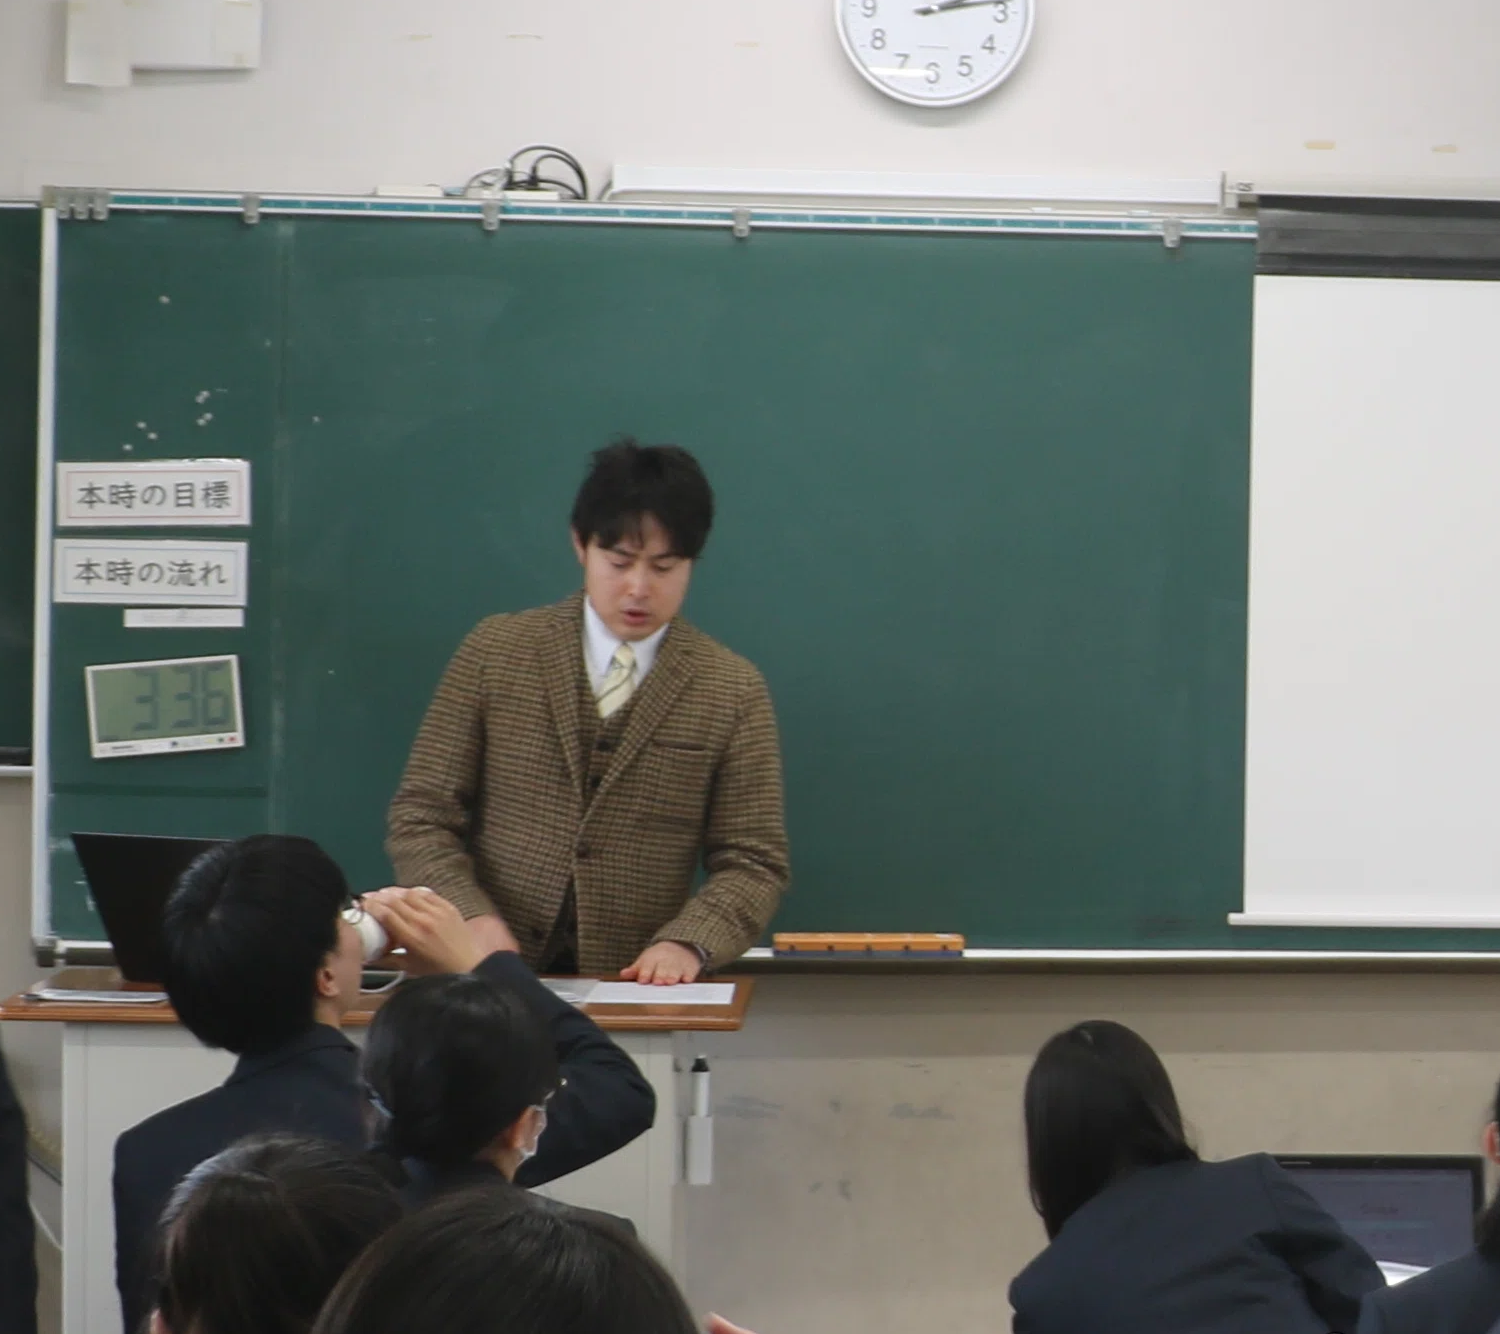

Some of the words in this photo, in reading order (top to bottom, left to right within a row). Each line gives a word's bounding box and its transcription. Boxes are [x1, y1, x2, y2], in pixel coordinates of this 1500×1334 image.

[993, 0, 1009, 23] 3
[870, 28, 886, 50] 8
[981, 34, 996, 54] 4
[894, 53, 910, 69] 7
[957, 55, 973, 77] 5
[925, 62, 940, 84] 6
[77, 479, 232, 510] 本時の目標
[73, 557, 228, 588] 本時の流れ
